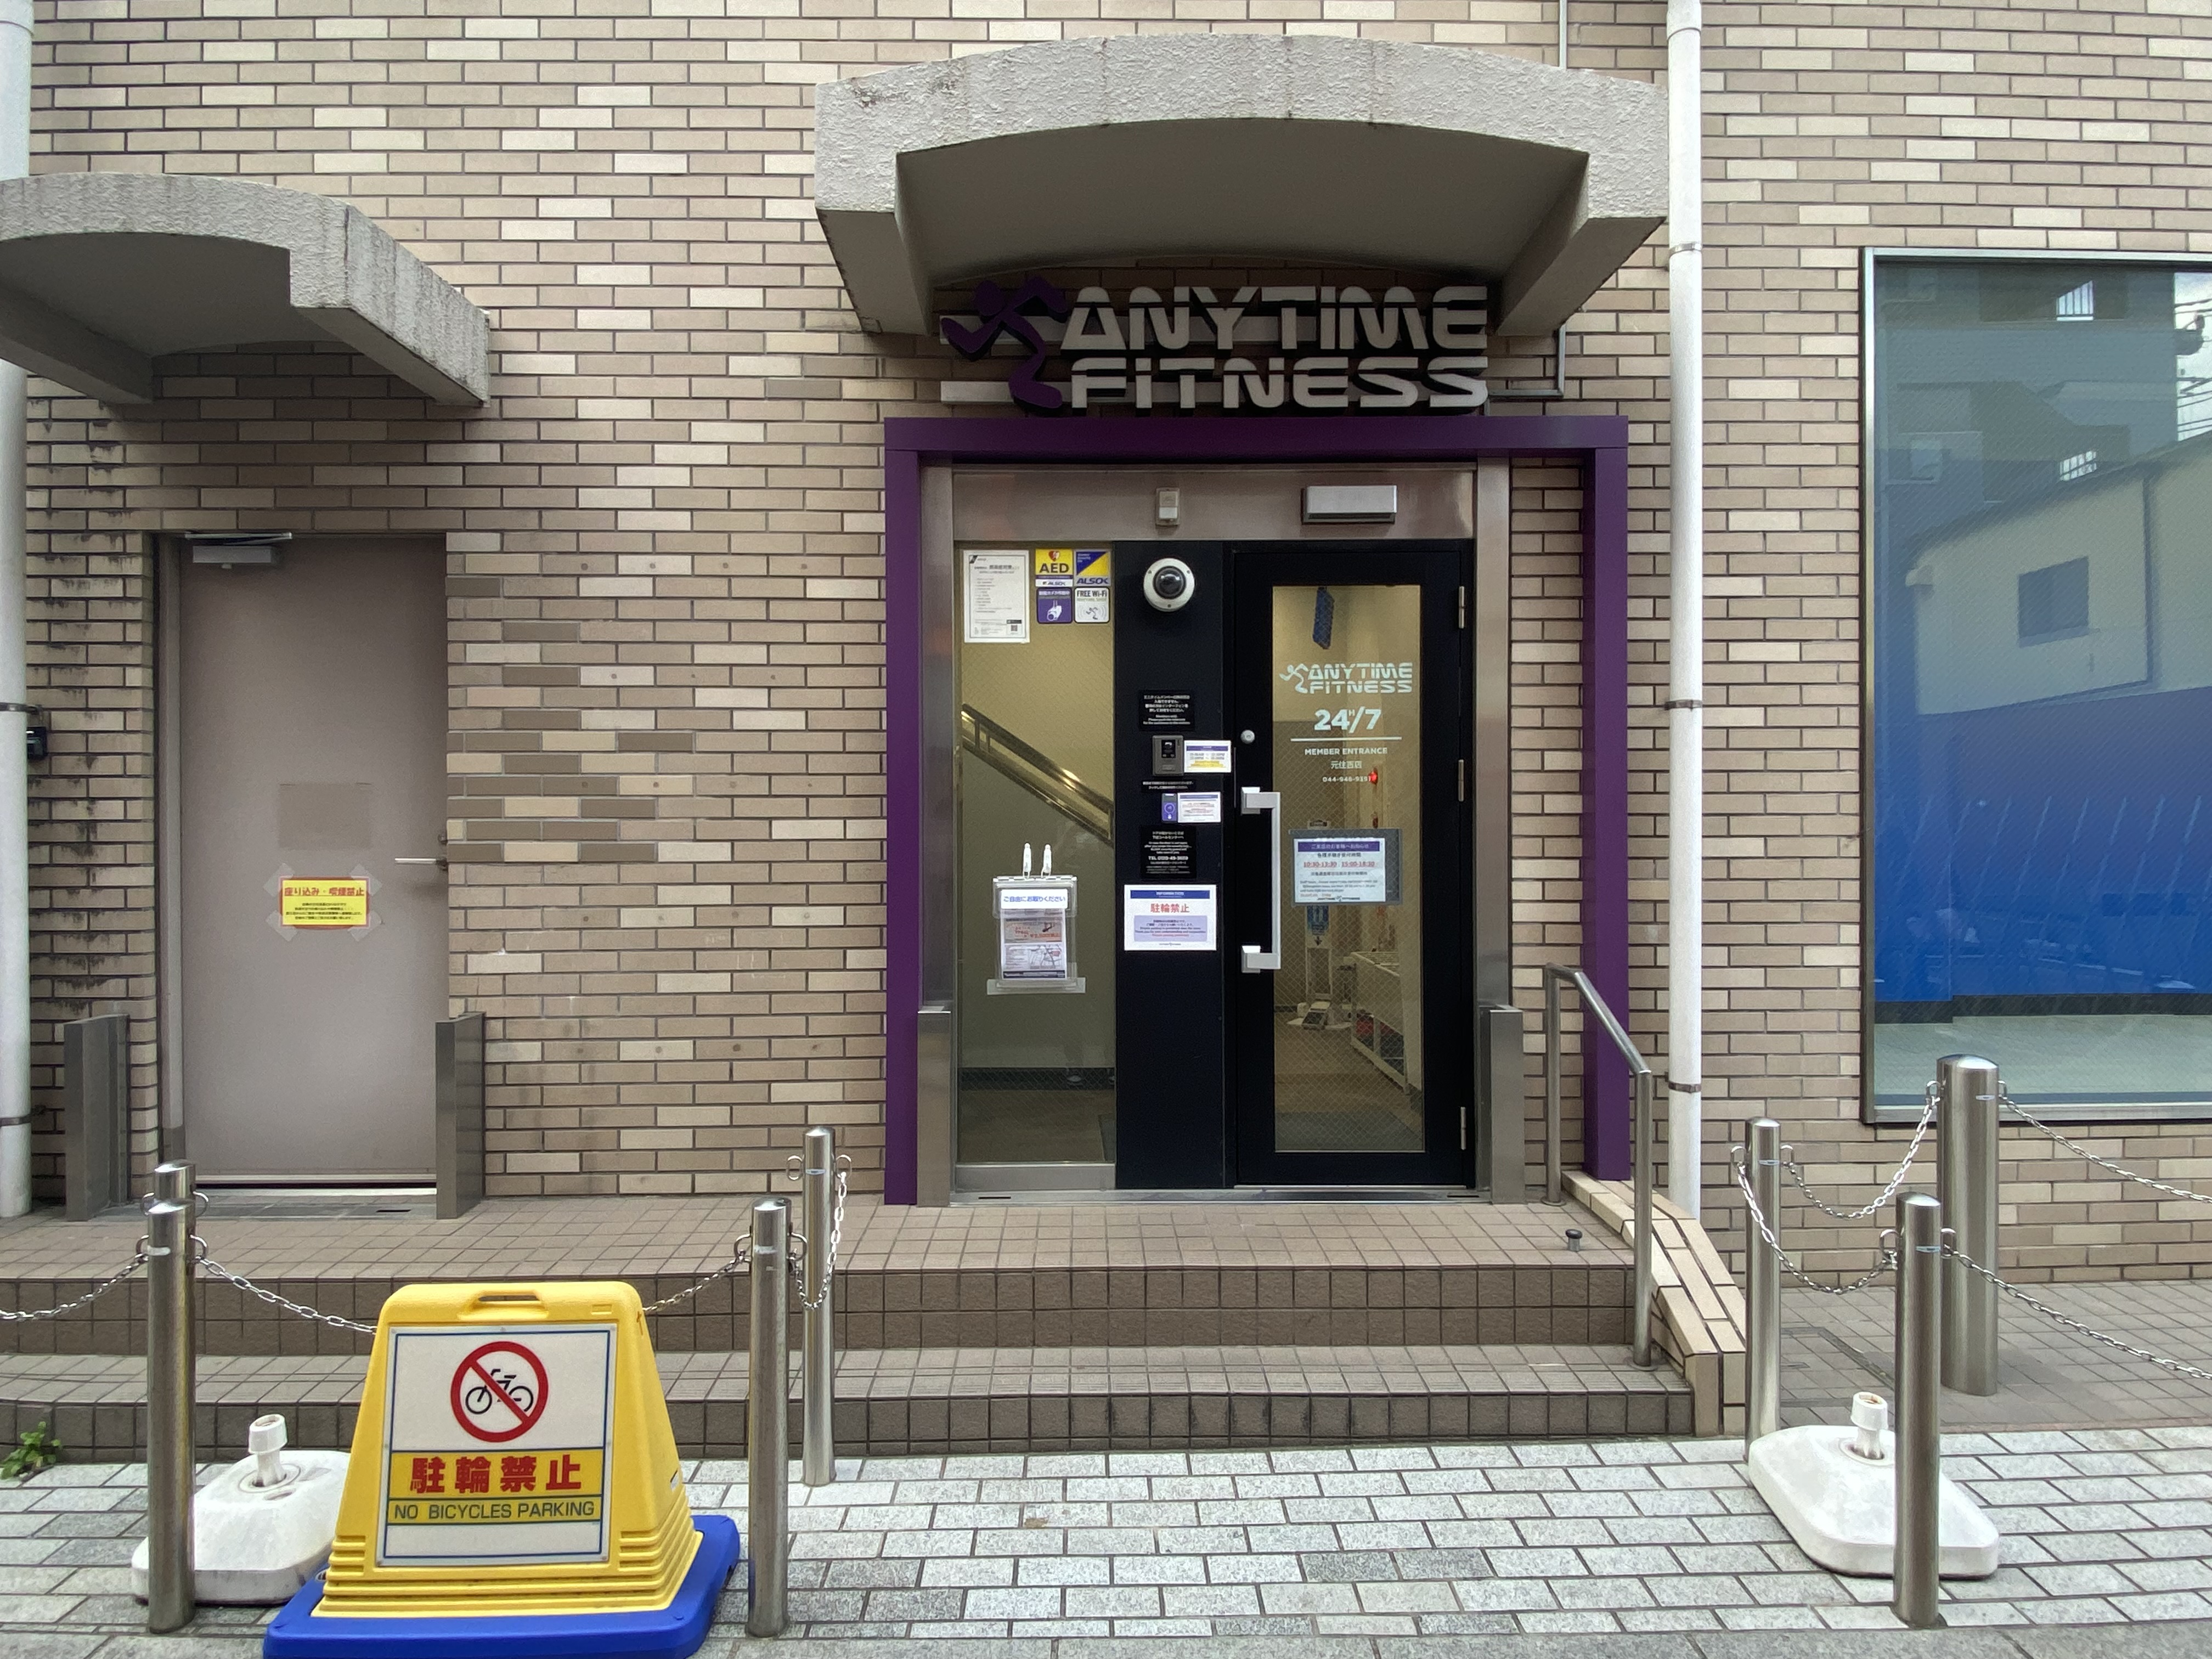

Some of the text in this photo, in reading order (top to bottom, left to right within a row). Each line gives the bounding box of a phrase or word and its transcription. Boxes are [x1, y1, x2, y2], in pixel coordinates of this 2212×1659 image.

[1060, 285, 1488, 350] ANYTIME
[1071, 357, 1488, 408] FITNESS
[1039, 563, 1070, 573] AED
[1307, 662, 1413, 680] ANYTIME
[1309, 680, 1413, 694] FITNESS
[1150, 903, 1190, 913] 駐輪禁止
[410, 1454, 582, 1494] 駐輪禁止
[394, 1500, 595, 1519] NO BICYCLES PARKING
